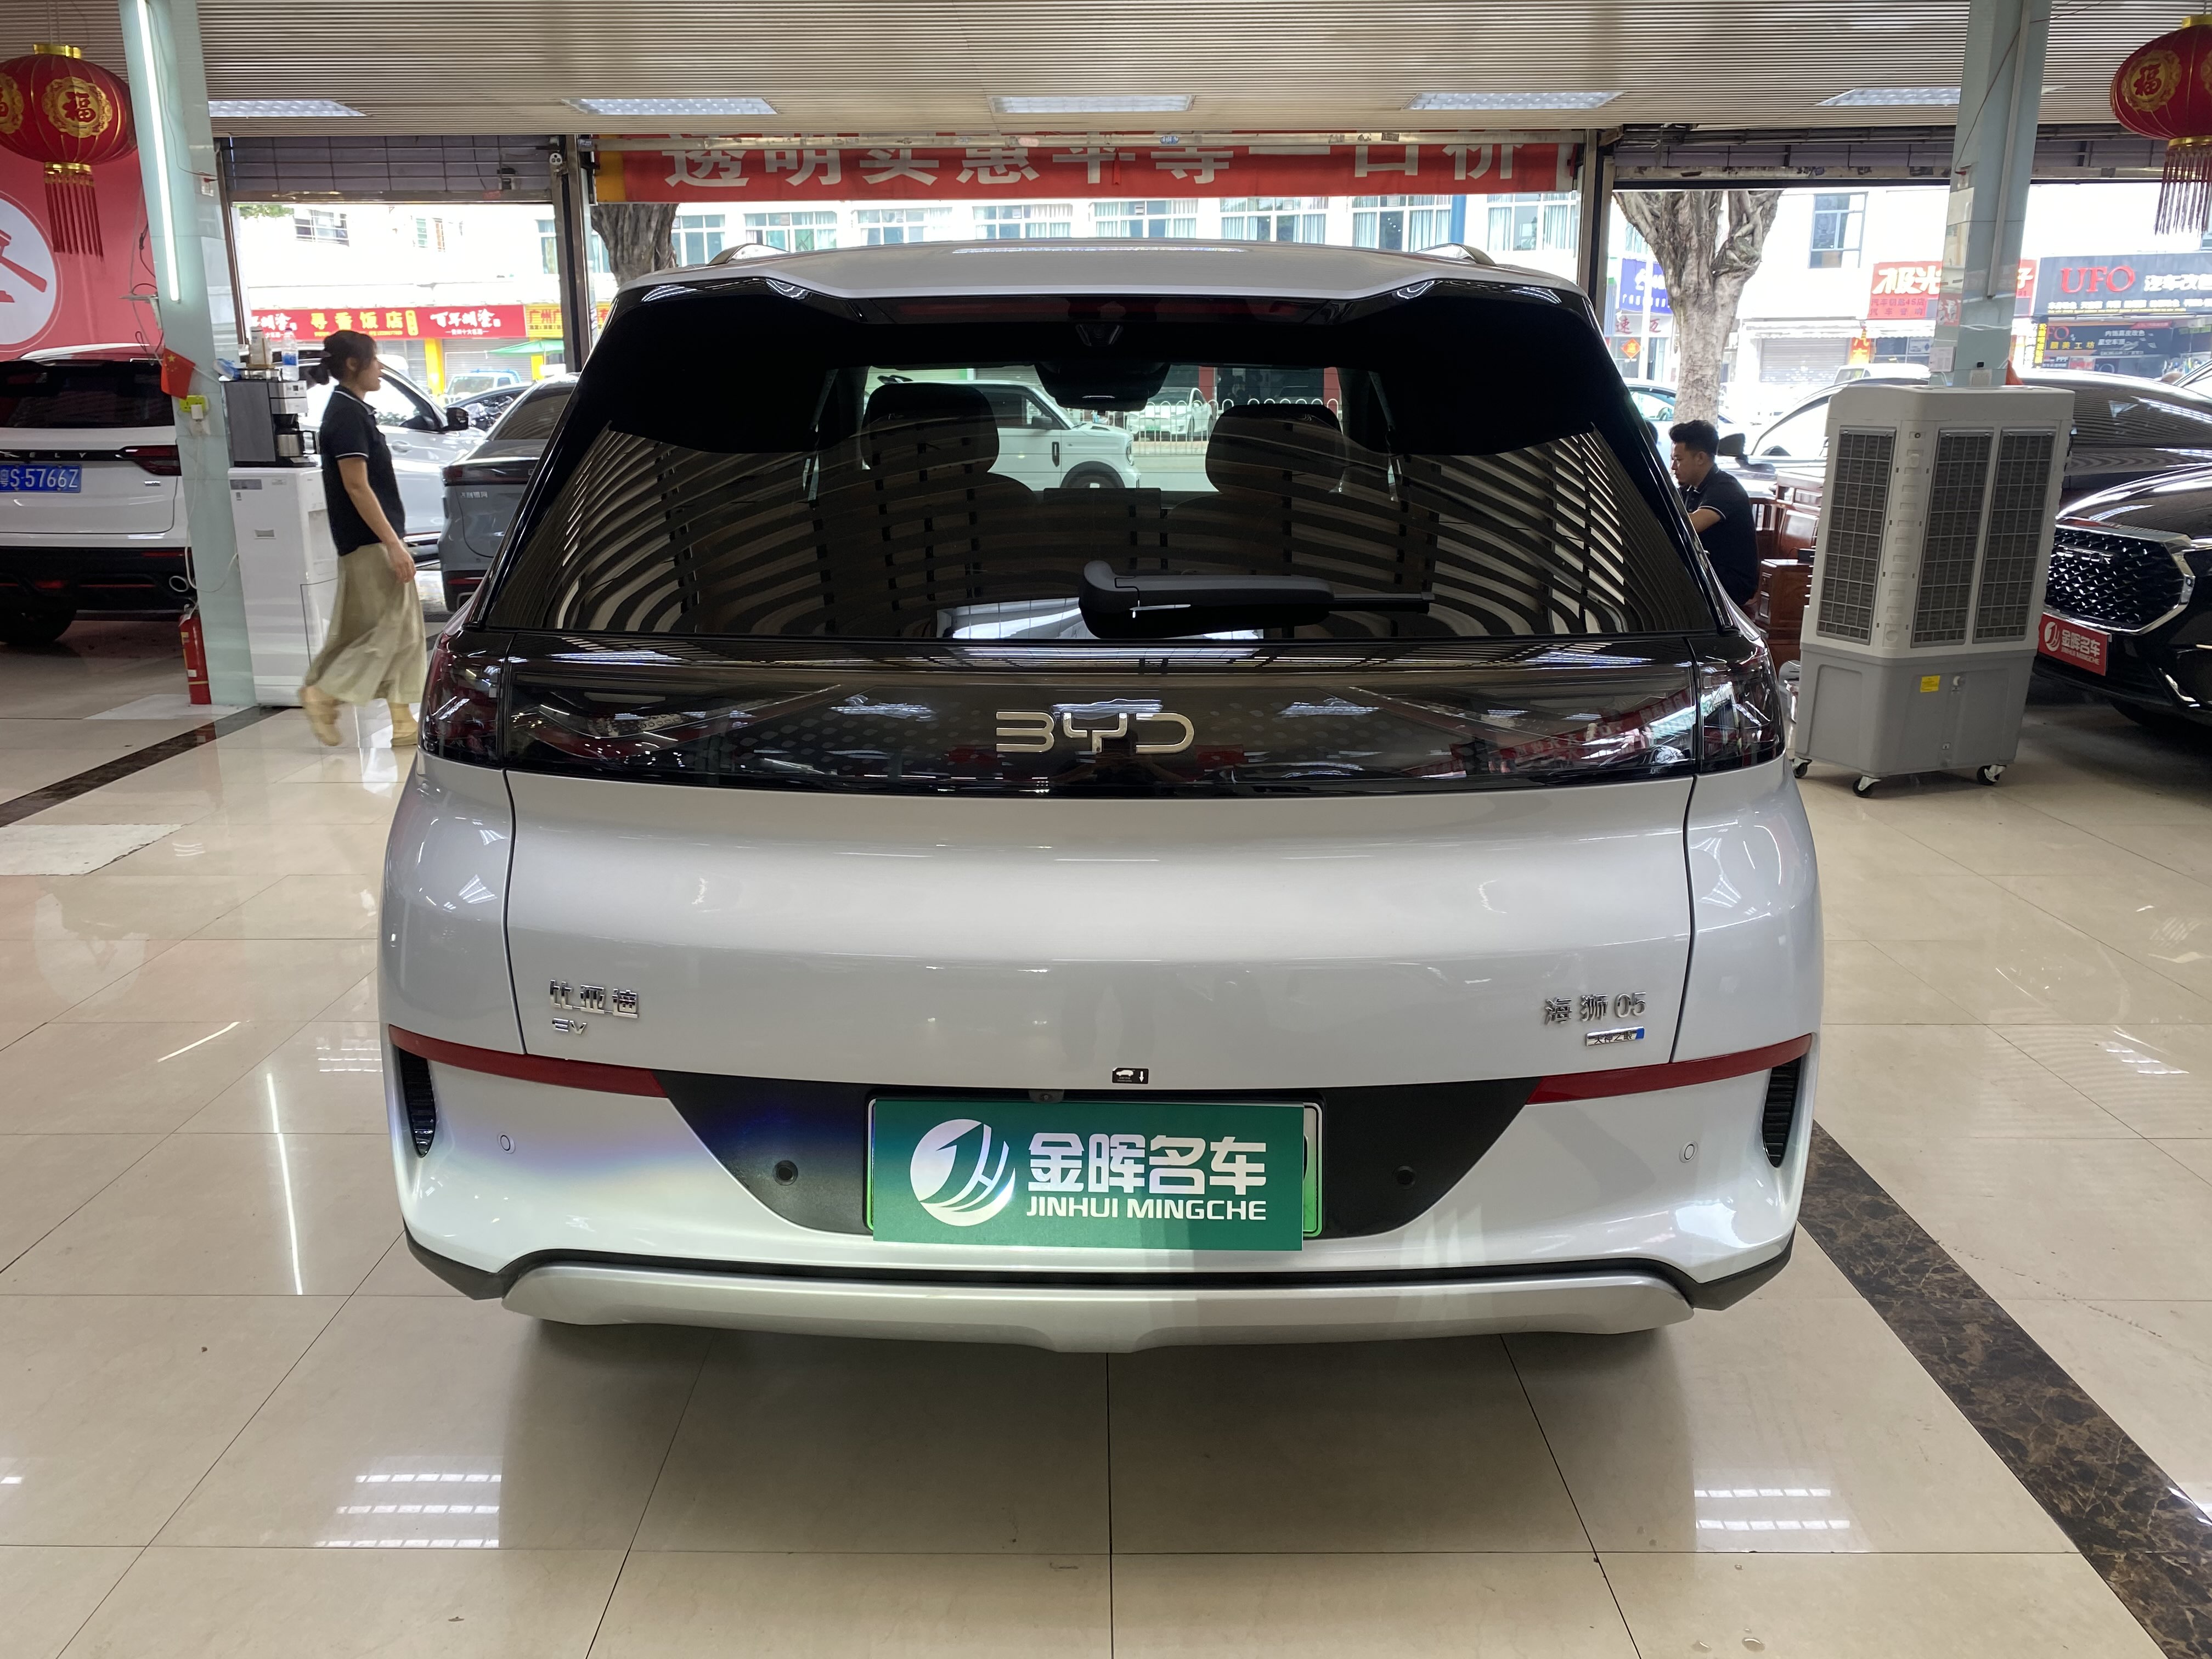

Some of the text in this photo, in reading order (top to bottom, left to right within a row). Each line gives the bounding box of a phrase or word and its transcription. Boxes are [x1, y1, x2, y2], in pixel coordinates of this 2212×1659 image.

[2132, 62, 2162, 97] 福
[61, 91, 96, 122] 福
[2061, 266, 2136, 293] UFO
[2062, 629, 2101, 657] 金晖名车
[996, 712, 1194, 754] BYD
[552, 1018, 587, 1035] EV
[1594, 1030, 1633, 1045] 天神之眼
[1028, 1132, 1267, 1195] 金晖名车
[1026, 1196, 1267, 1221] JINHUI MINGCHE
